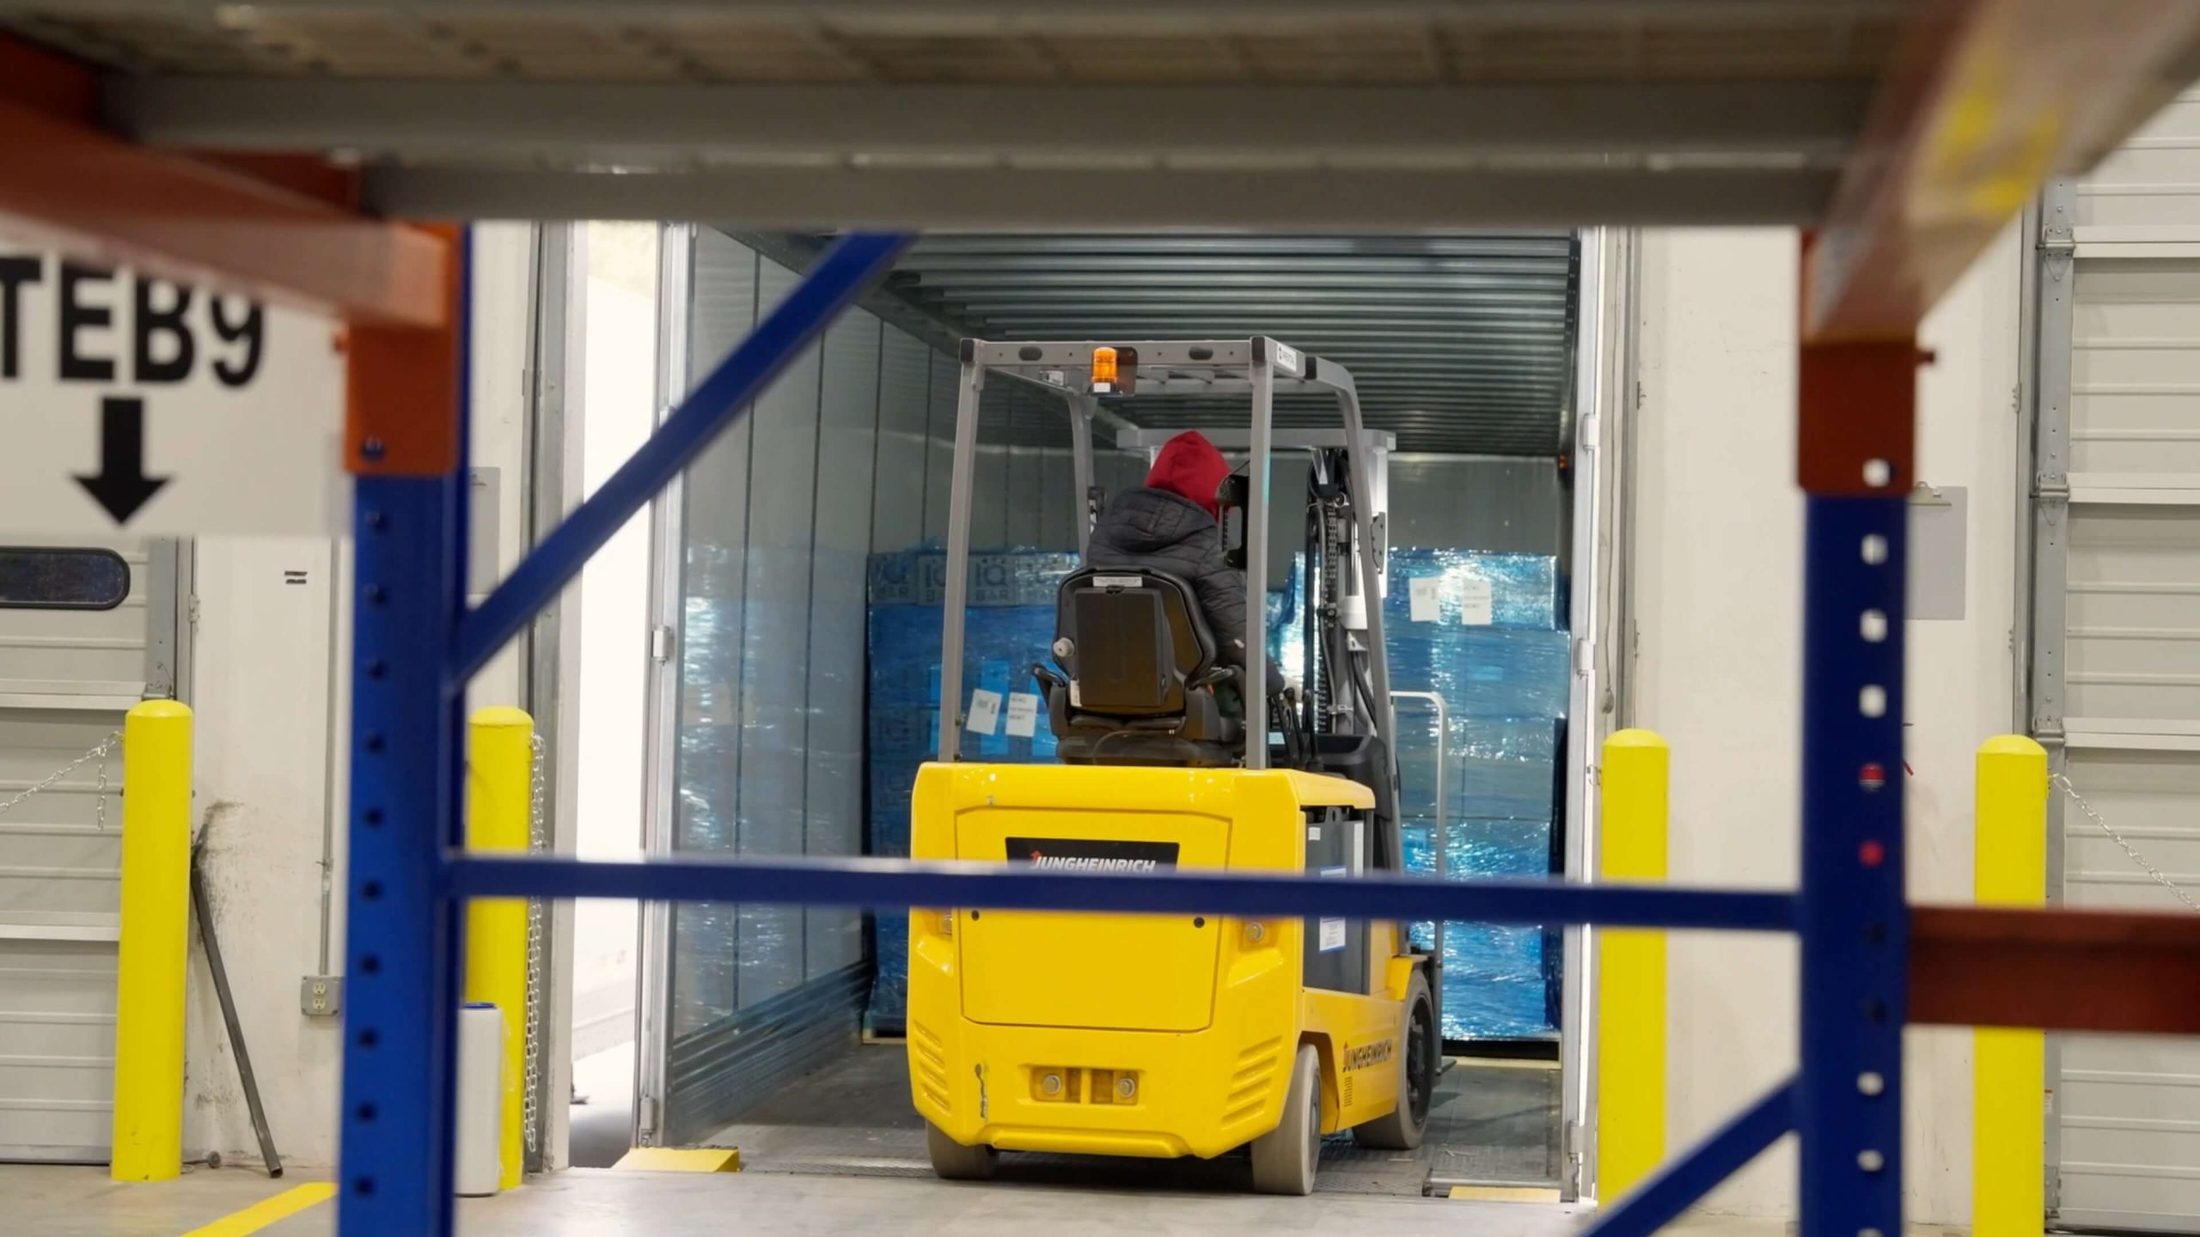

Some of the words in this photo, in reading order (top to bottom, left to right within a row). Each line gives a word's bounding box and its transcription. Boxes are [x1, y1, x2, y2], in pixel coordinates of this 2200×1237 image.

[975, 557, 1009, 587] IQ
[975, 588, 1009, 601] BAR
[1029, 856, 1157, 874] JUNGHEINRICH
